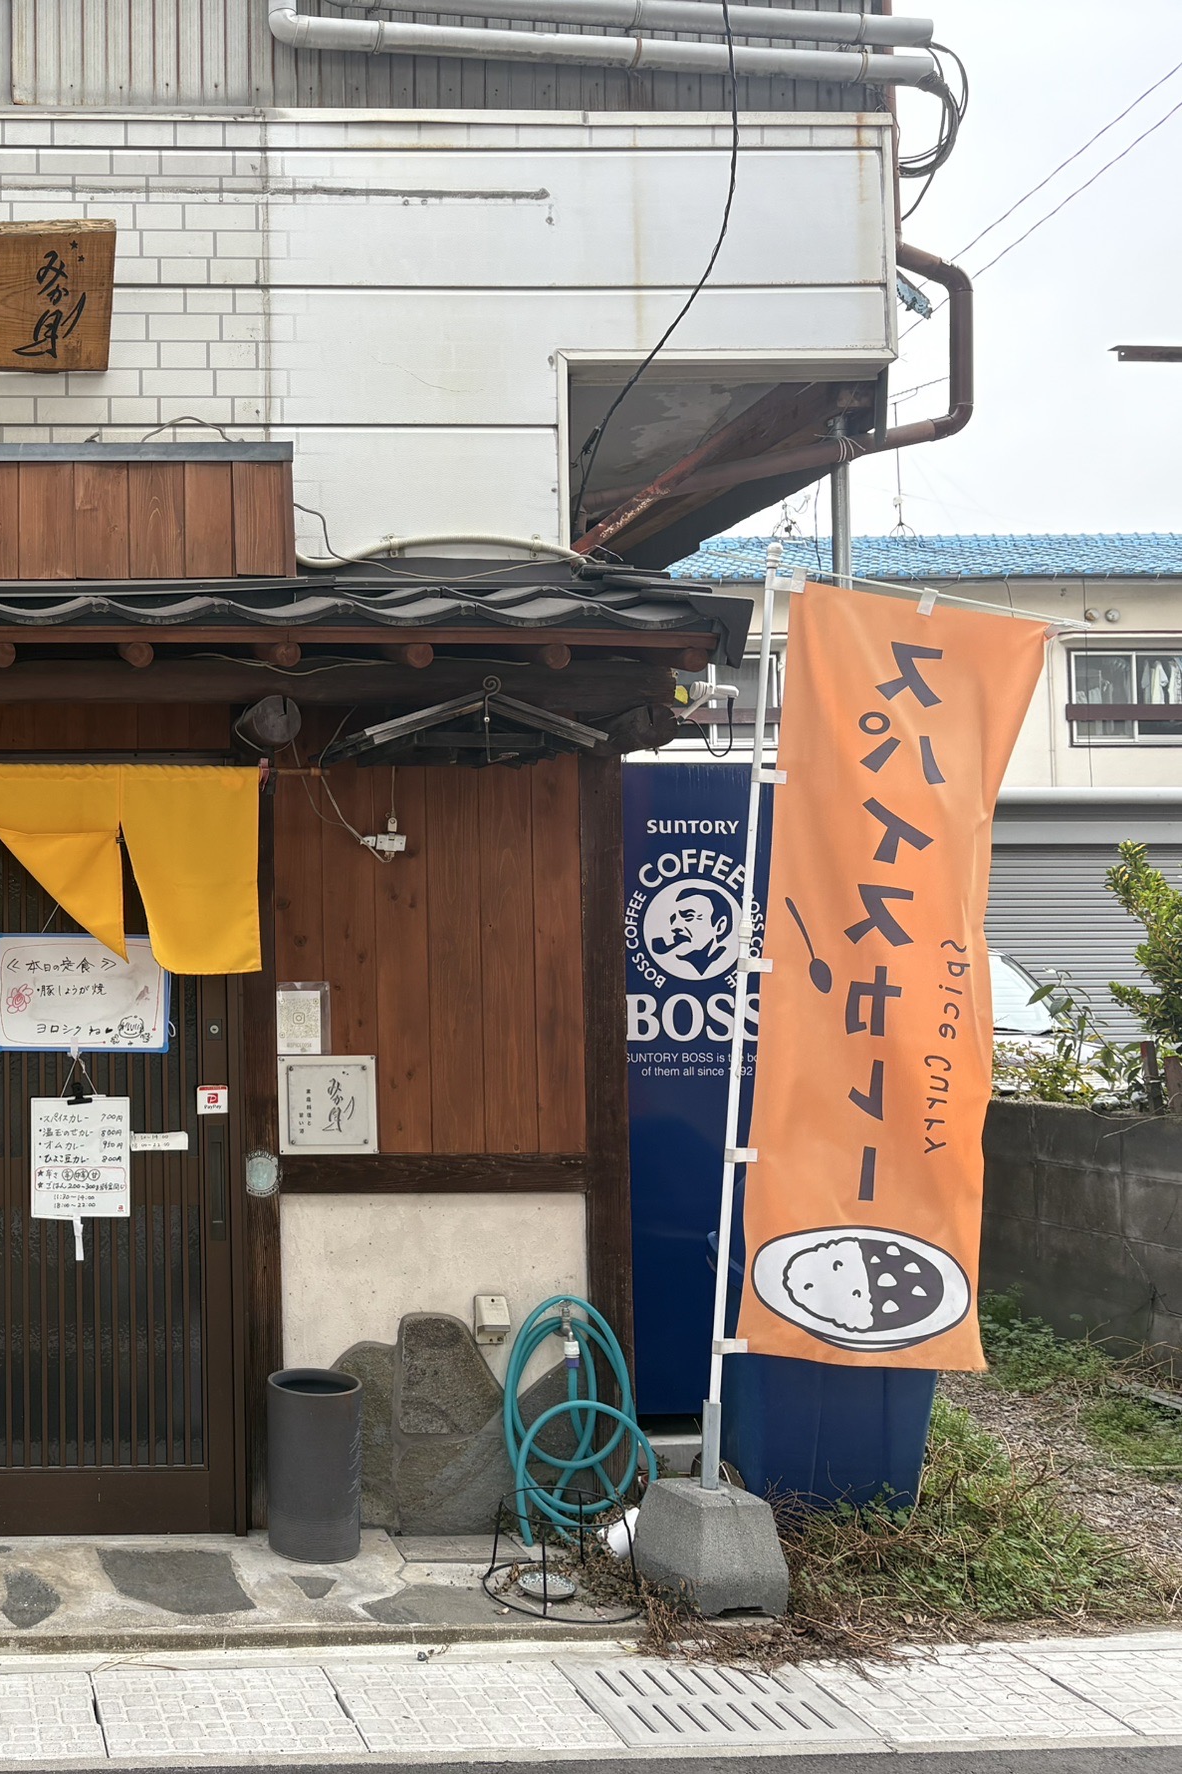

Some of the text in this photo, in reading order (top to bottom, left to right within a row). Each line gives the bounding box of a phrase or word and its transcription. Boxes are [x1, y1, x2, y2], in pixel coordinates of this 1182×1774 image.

[638, 848, 747, 890] COFFEE
[623, 890, 667, 989] BOSS COFFEE
[625, 993, 760, 1042] BOSS
[681, 1052, 714, 1063] BOSS
[716, 1052, 726, 1063] is
[641, 1066, 652, 1077] of
[654, 1066, 680, 1077] them
[682, 1066, 695, 1077] all
[697, 1066, 725, 1077] since
[100, 1113, 123, 1122] 700円
